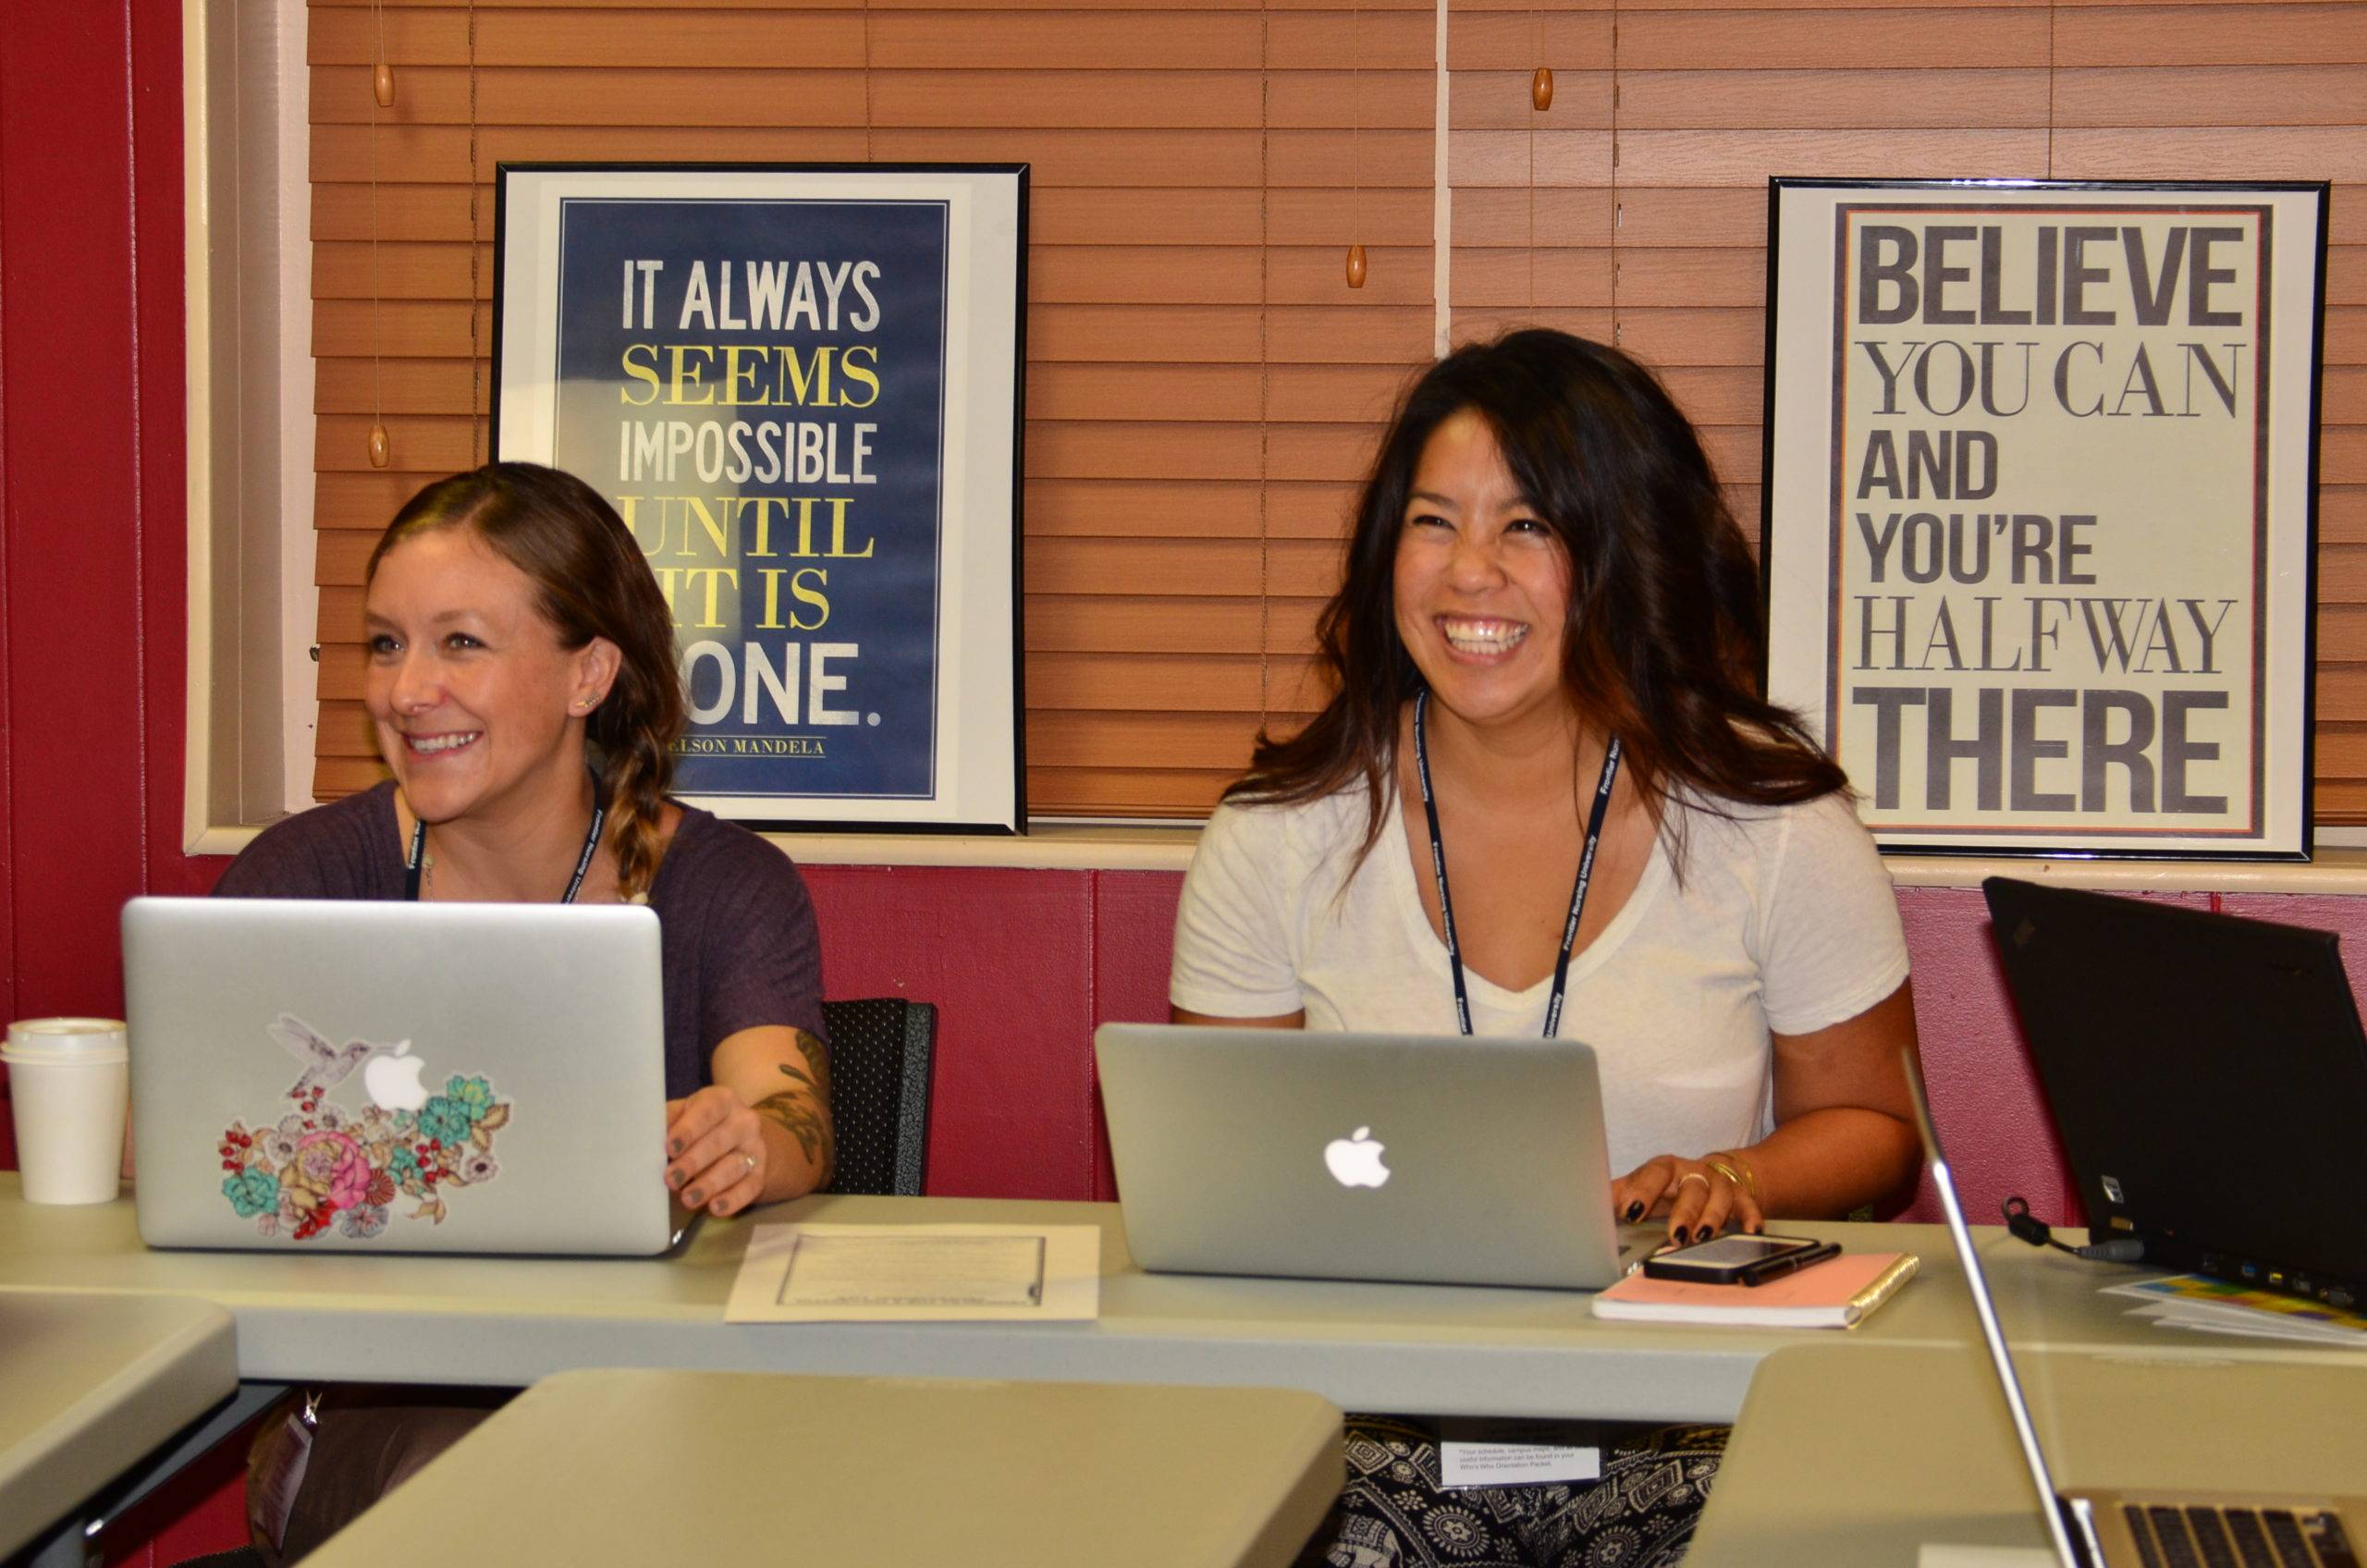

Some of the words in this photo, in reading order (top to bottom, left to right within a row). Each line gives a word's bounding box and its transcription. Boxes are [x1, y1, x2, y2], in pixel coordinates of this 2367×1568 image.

[622, 260, 664, 329] IT
[679, 260, 881, 333] ALWAYS
[1858, 225, 2245, 327] BELIEVE
[620, 343, 880, 409] SEEMS
[1854, 339, 2041, 418] YOU
[2053, 340, 2248, 420] CAN
[619, 420, 877, 484] IMPOSSIBLE
[1857, 429, 2000, 501] AND
[616, 496, 875, 558] UNTIL
[1856, 512, 2098, 586] YOU'RE
[654, 567, 739, 629] IT
[754, 568, 830, 631] IS
[1852, 594, 2239, 675] HALFWAY
[678, 640, 881, 727] ONE.
[668, 738, 727, 754] ELSON
[733, 739, 825, 755] MANDELA
[1600, 760, 1616, 795] Frontier
[1851, 686, 2230, 815] THERE
[1579, 835, 1598, 878] University
[1572, 880, 1588, 915] Nursing
[1564, 915, 1577, 950] Frontier
